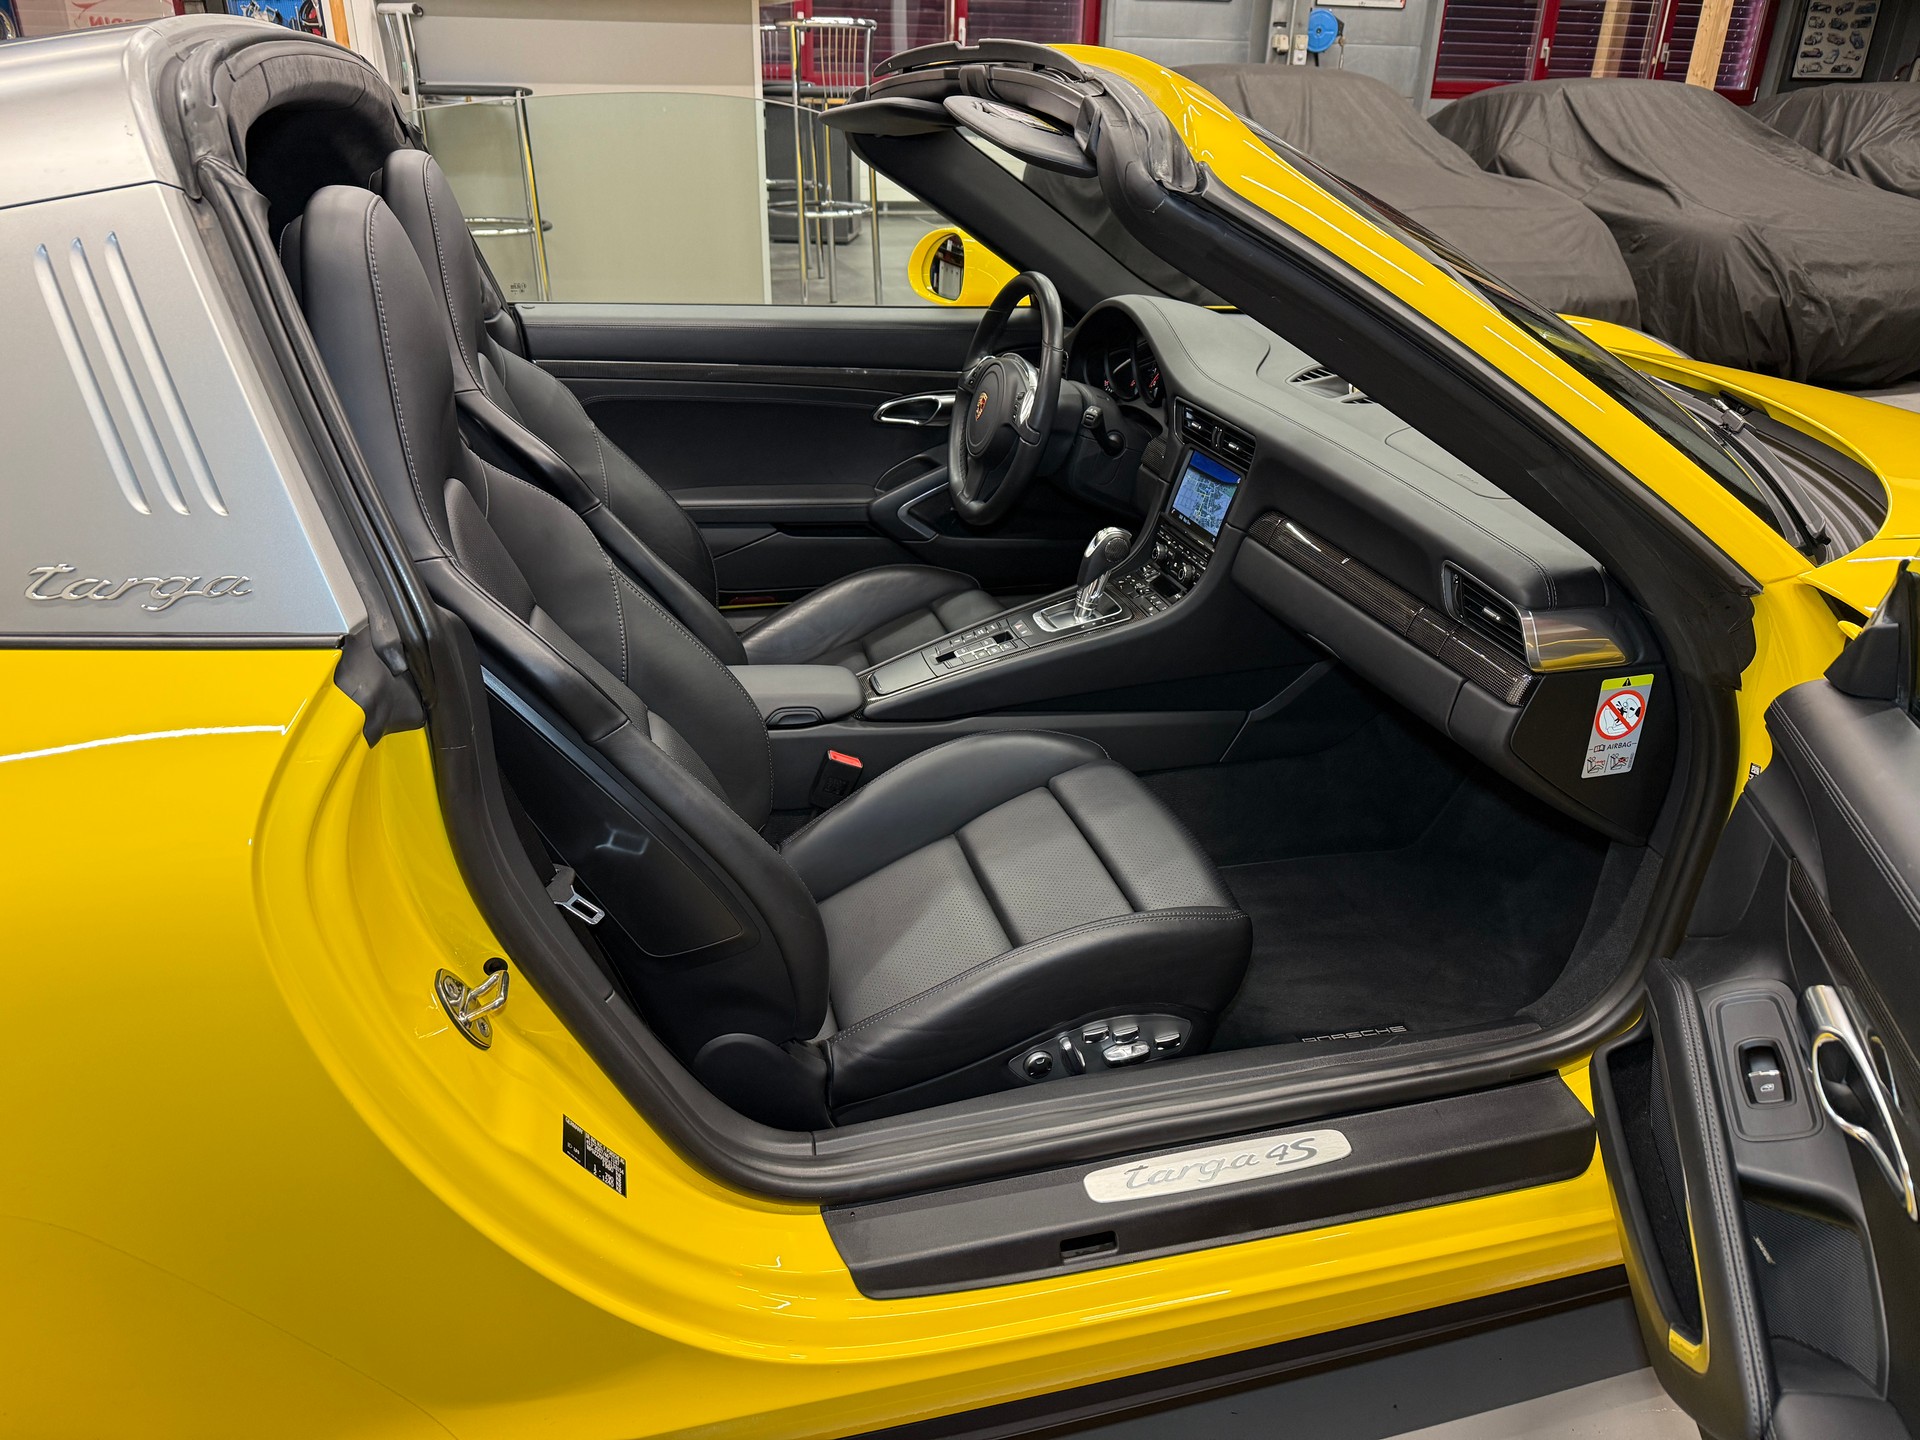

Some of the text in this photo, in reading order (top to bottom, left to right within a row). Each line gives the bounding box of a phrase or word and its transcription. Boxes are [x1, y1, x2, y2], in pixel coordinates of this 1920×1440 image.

[24, 563, 253, 612] targa
[1606, 741, 1633, 751] AIRBAG
[1123, 1137, 1319, 1190] targa 4S
